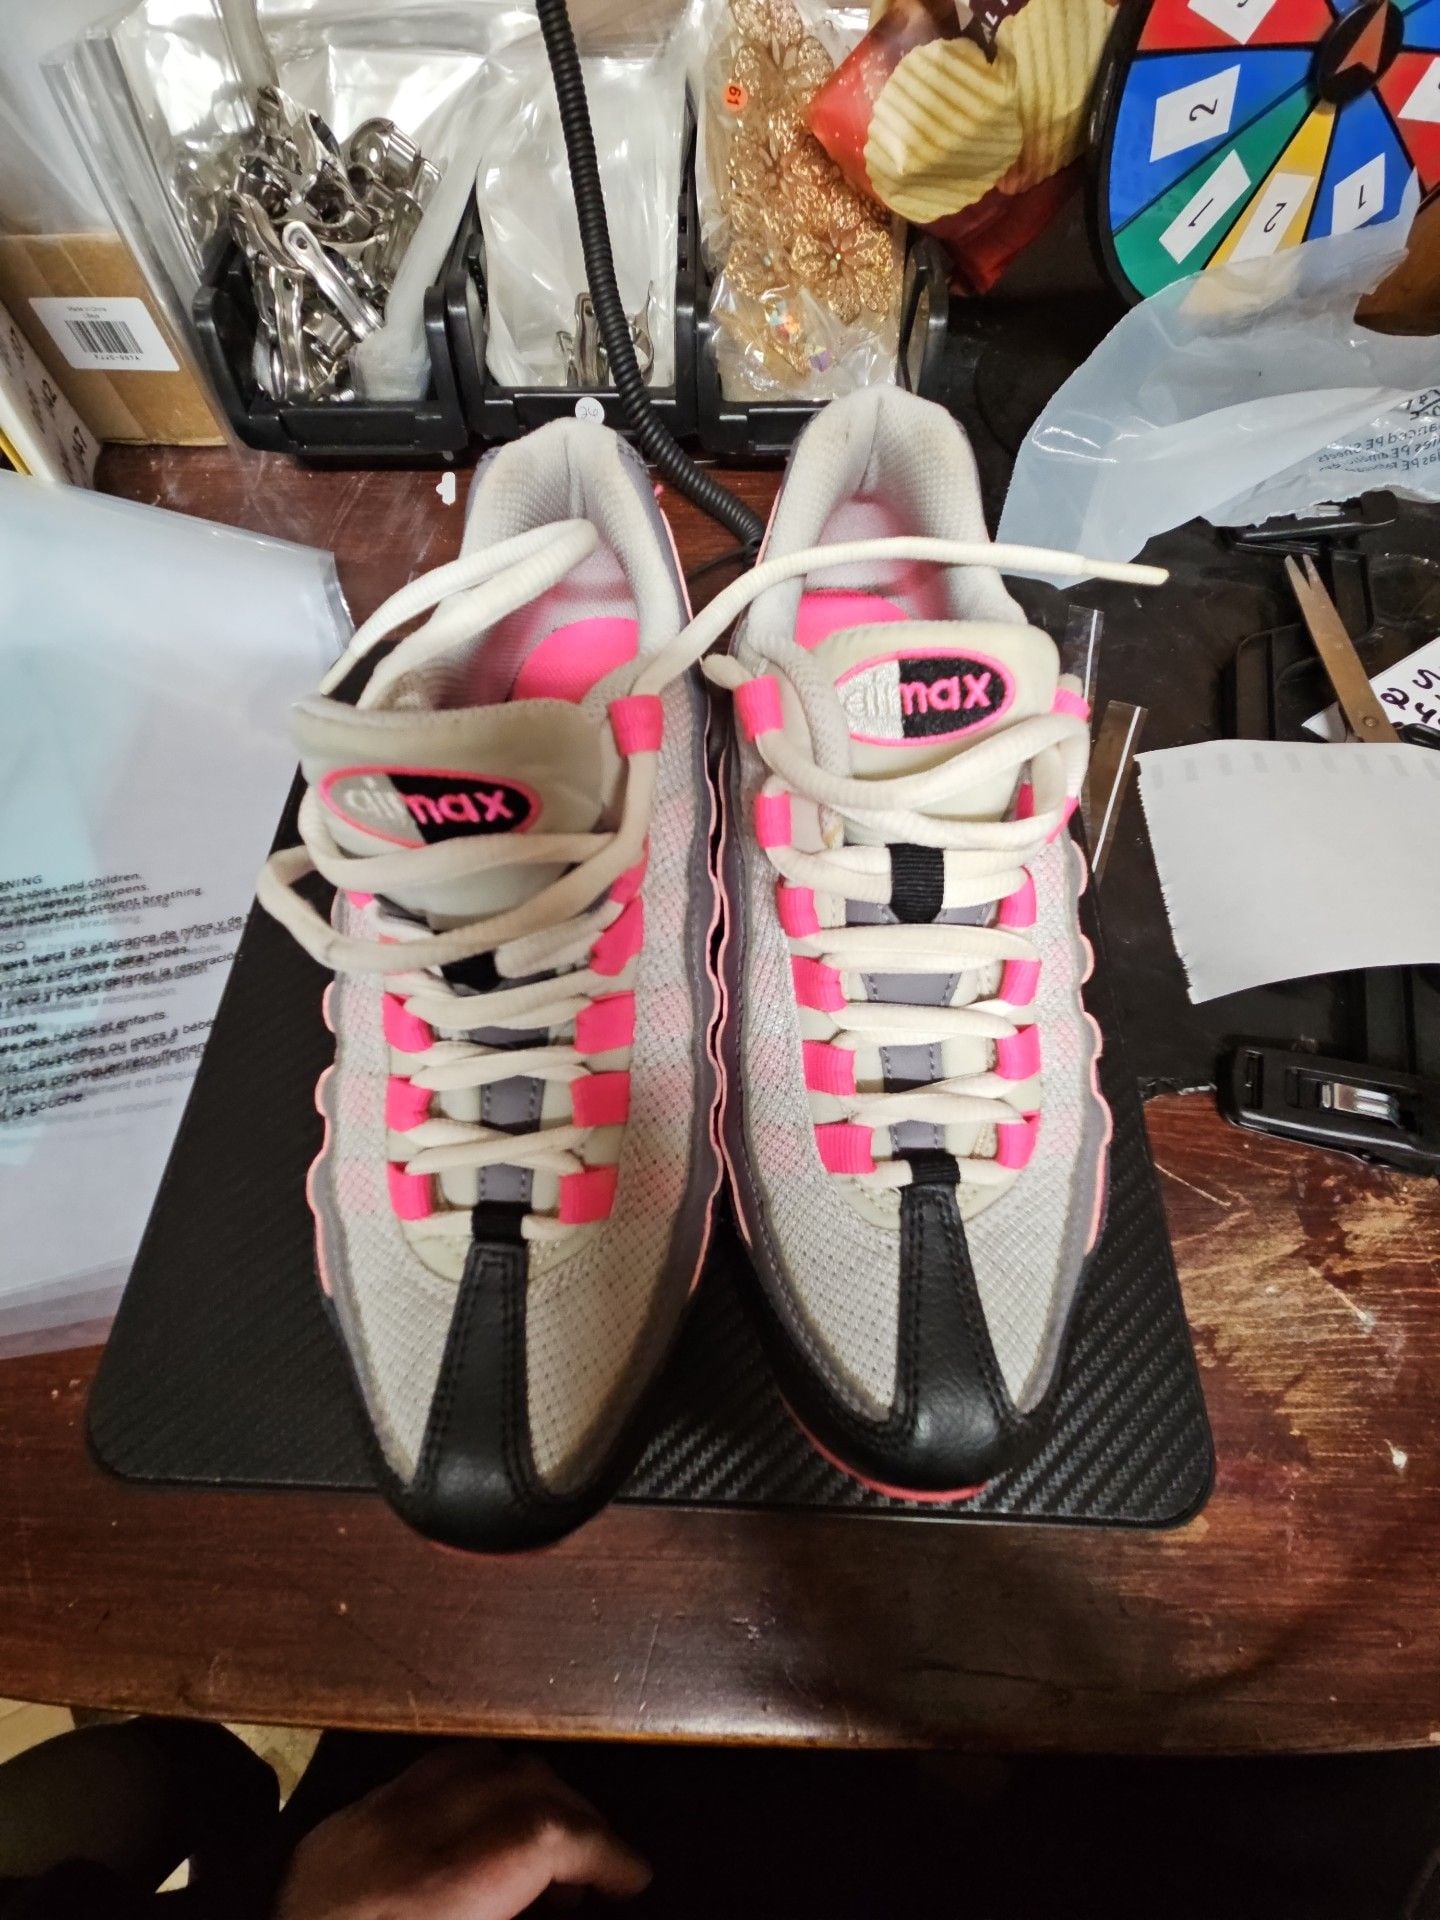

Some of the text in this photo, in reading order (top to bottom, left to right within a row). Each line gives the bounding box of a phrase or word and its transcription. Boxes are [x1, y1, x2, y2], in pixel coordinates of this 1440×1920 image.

[1188, 98, 1218, 122] 2
[1357, 184, 1367, 210] 1
[1188, 198, 1214, 227] 1
[1263, 202, 1287, 233] 2
